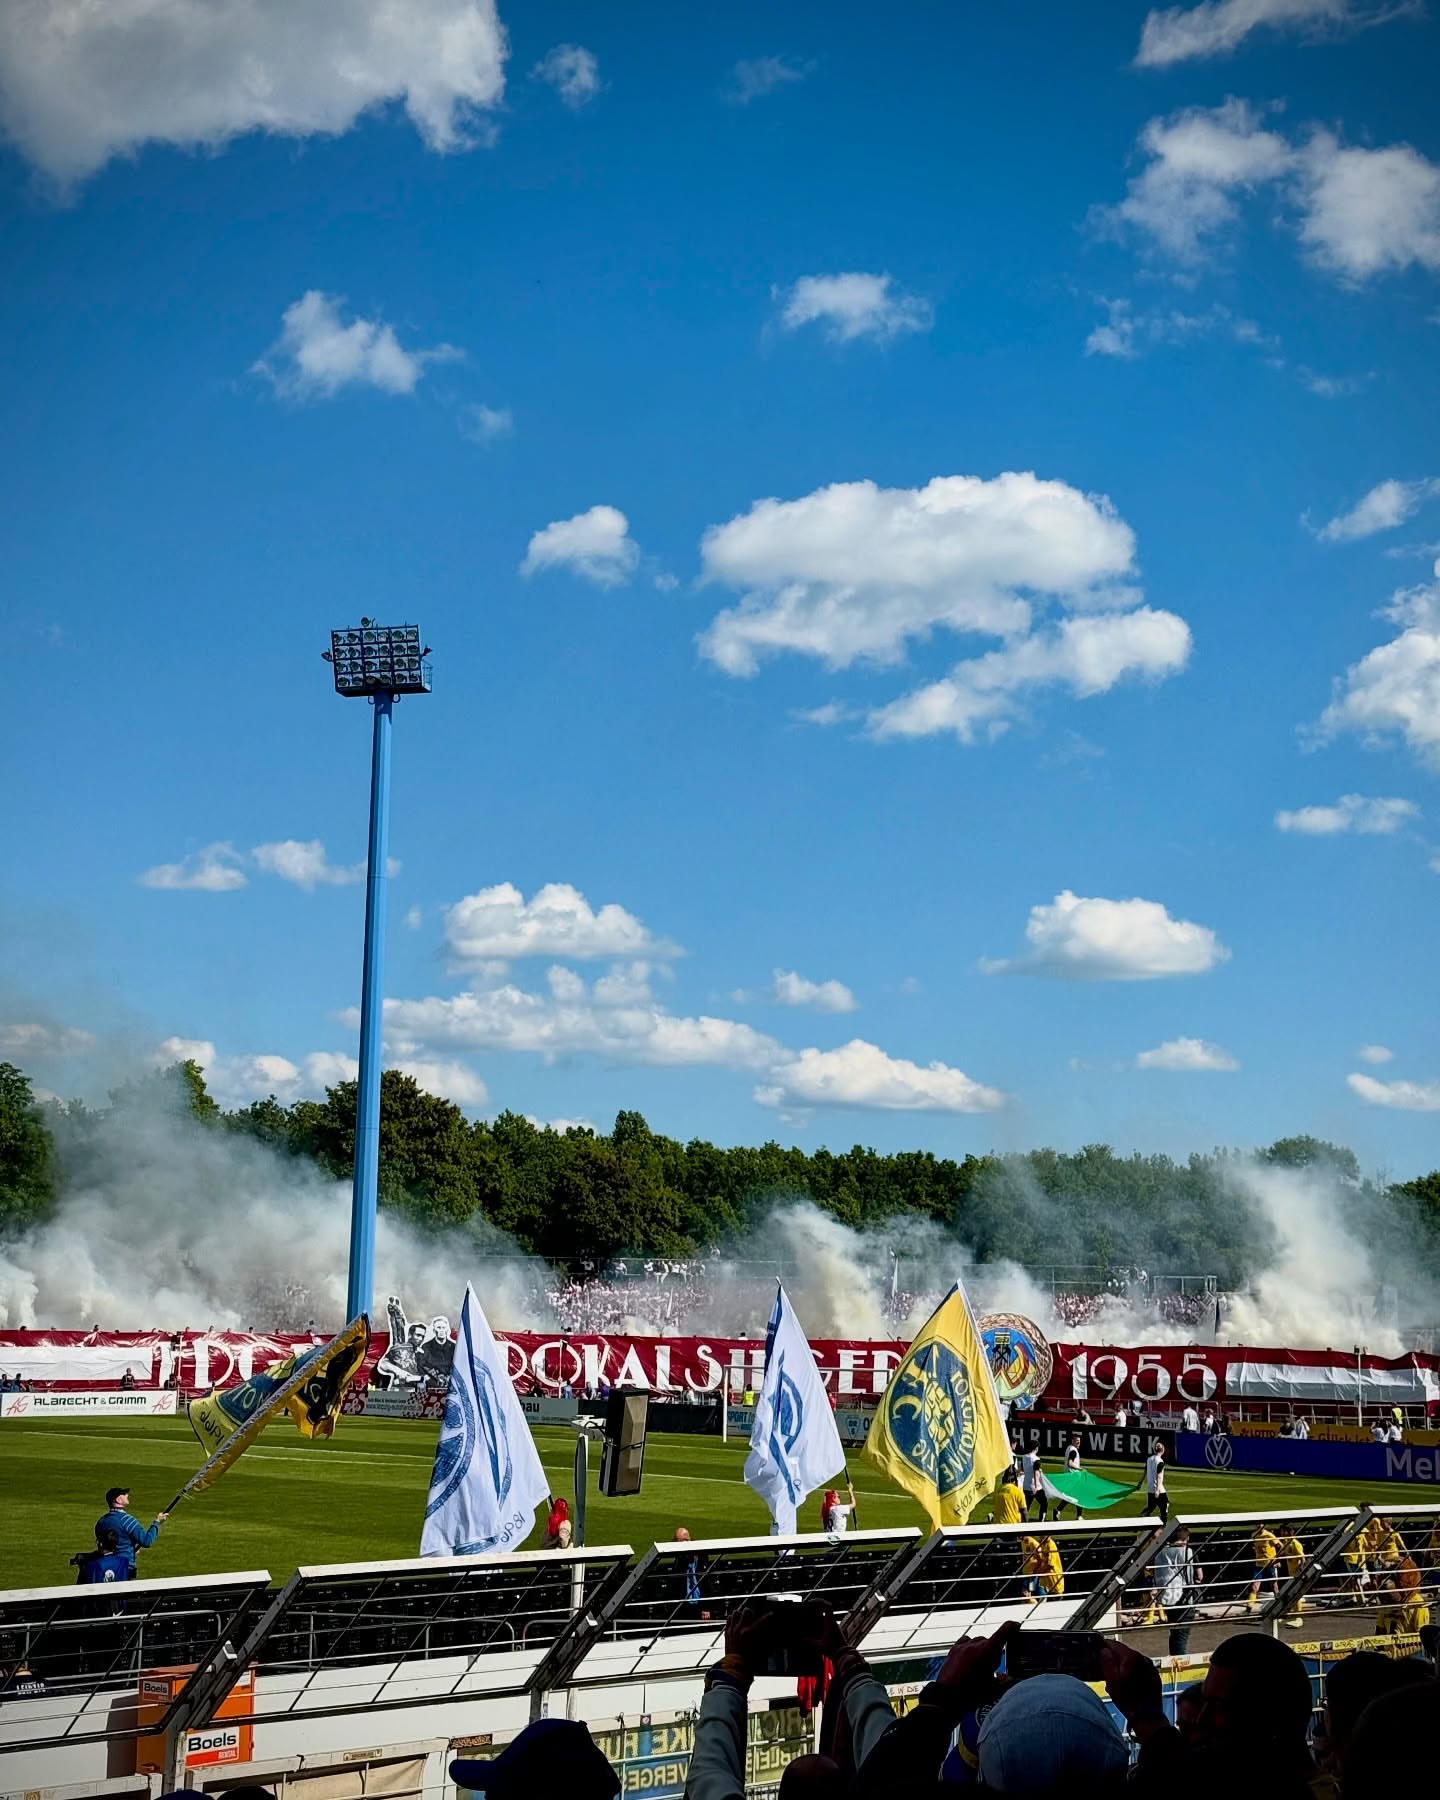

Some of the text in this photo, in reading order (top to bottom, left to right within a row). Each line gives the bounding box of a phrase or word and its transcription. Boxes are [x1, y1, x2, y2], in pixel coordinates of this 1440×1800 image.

[1068, 1351, 1218, 1401] 1955
[33, 1396, 98, 1406] ALBRECHT
[108, 1396, 146, 1405] GRIMM
[144, 1682, 168, 1693] Boels
[188, 1732, 237, 1751] Boels
